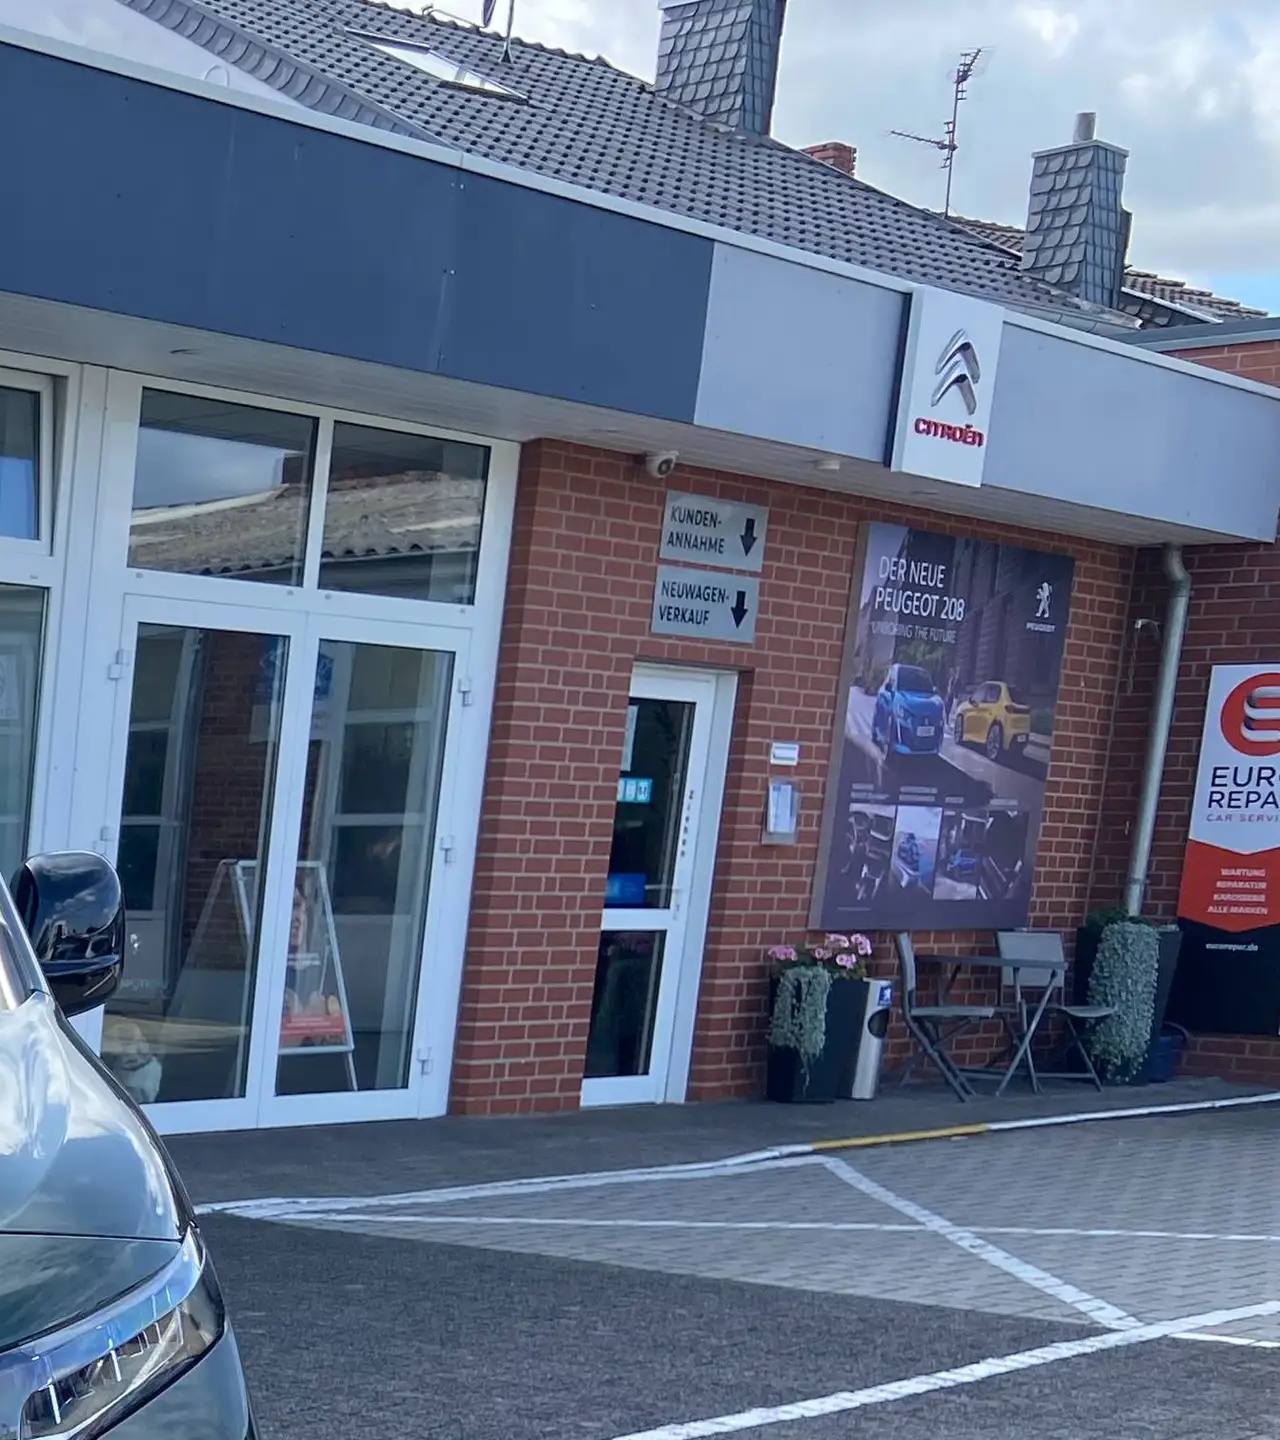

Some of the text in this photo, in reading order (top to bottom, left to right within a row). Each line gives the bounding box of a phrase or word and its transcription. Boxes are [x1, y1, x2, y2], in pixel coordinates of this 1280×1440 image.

[670, 506, 722, 528] KUNDEN-
[667, 531, 725, 555] ANNAHME
[878, 556, 946, 588] DER NEUE
[661, 581, 730, 604] NEUWAGEN-
[874, 587, 966, 621] PEUGEOT 208
[659, 605, 711, 626] VERKAUF
[1210, 766, 1280, 788] EUR
[1206, 813, 1233, 823] CAR
